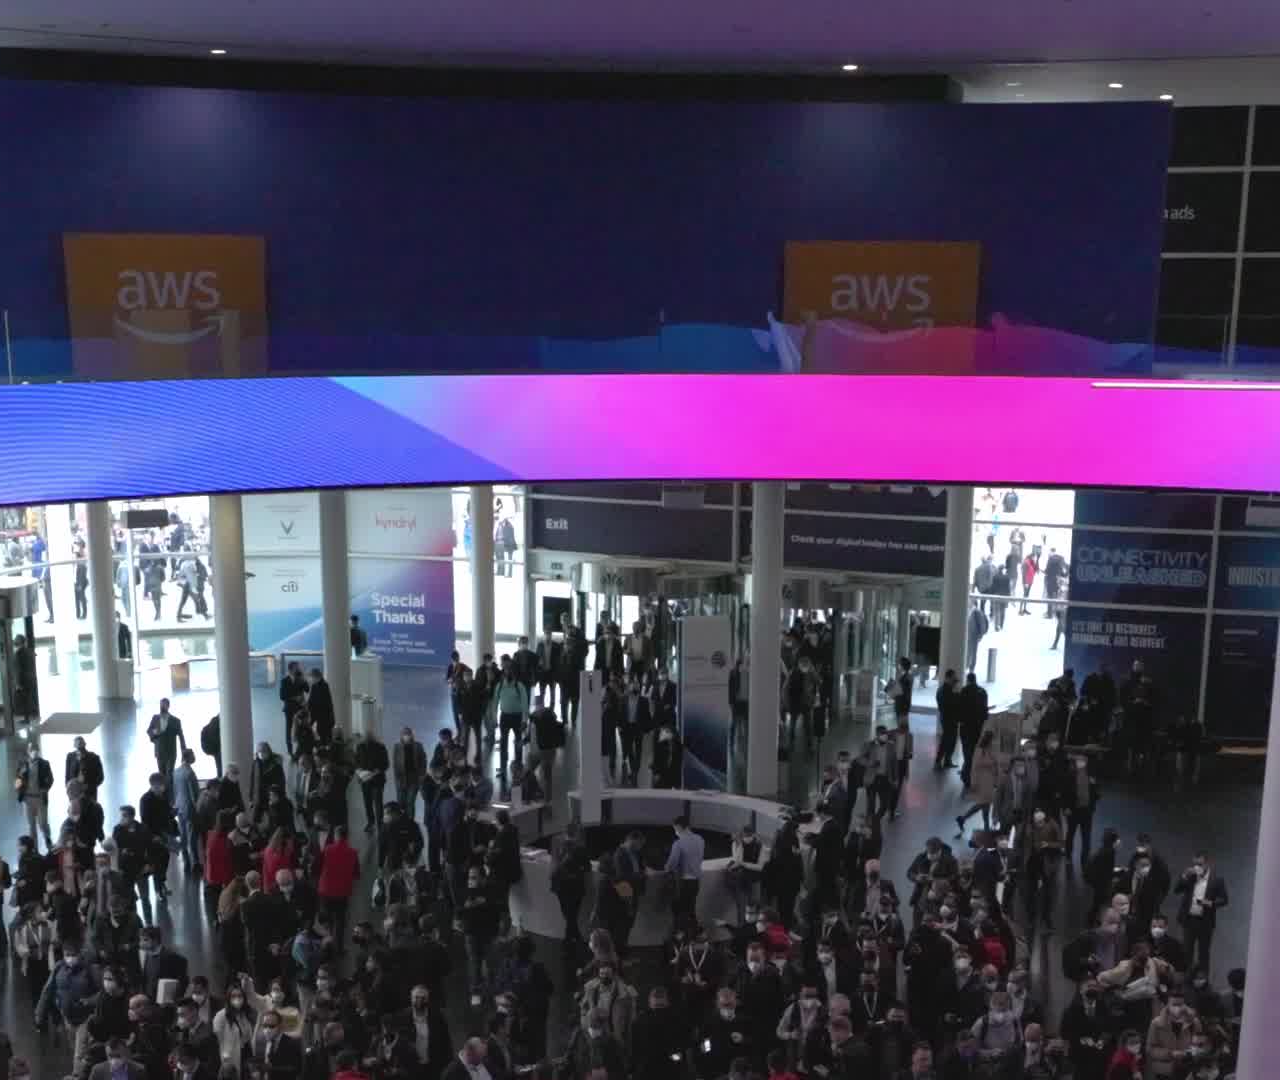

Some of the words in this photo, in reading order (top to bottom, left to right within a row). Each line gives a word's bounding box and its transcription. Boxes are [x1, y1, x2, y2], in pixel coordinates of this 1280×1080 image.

[117, 266, 221, 310] aws
[830, 272, 932, 313] aws
[545, 517, 569, 530] Exit
[1077, 547, 1209, 568] CONNECTIVITY
[370, 591, 425, 610] Special
[372, 608, 425, 625] Thanks
